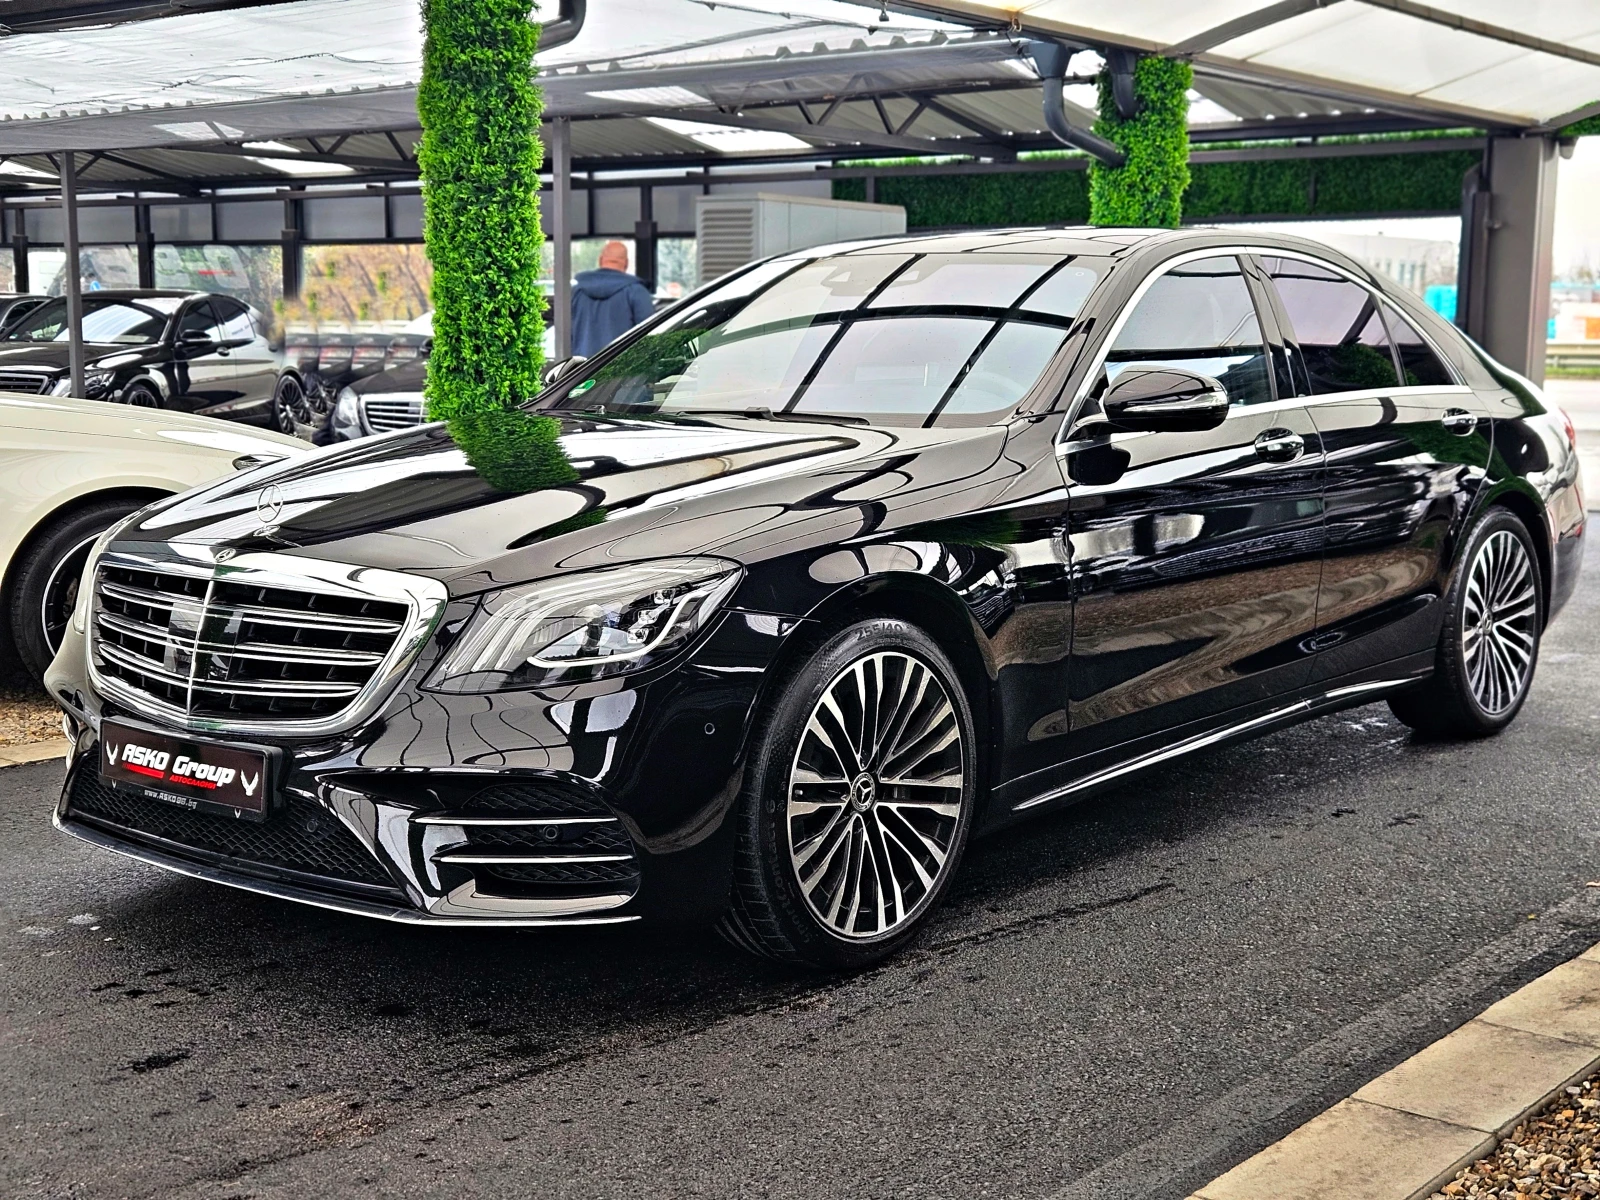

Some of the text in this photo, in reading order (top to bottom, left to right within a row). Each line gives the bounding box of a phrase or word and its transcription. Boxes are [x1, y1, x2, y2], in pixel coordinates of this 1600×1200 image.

[855, 622, 904, 641] 255/40
[121, 743, 236, 787] ASKO Group
